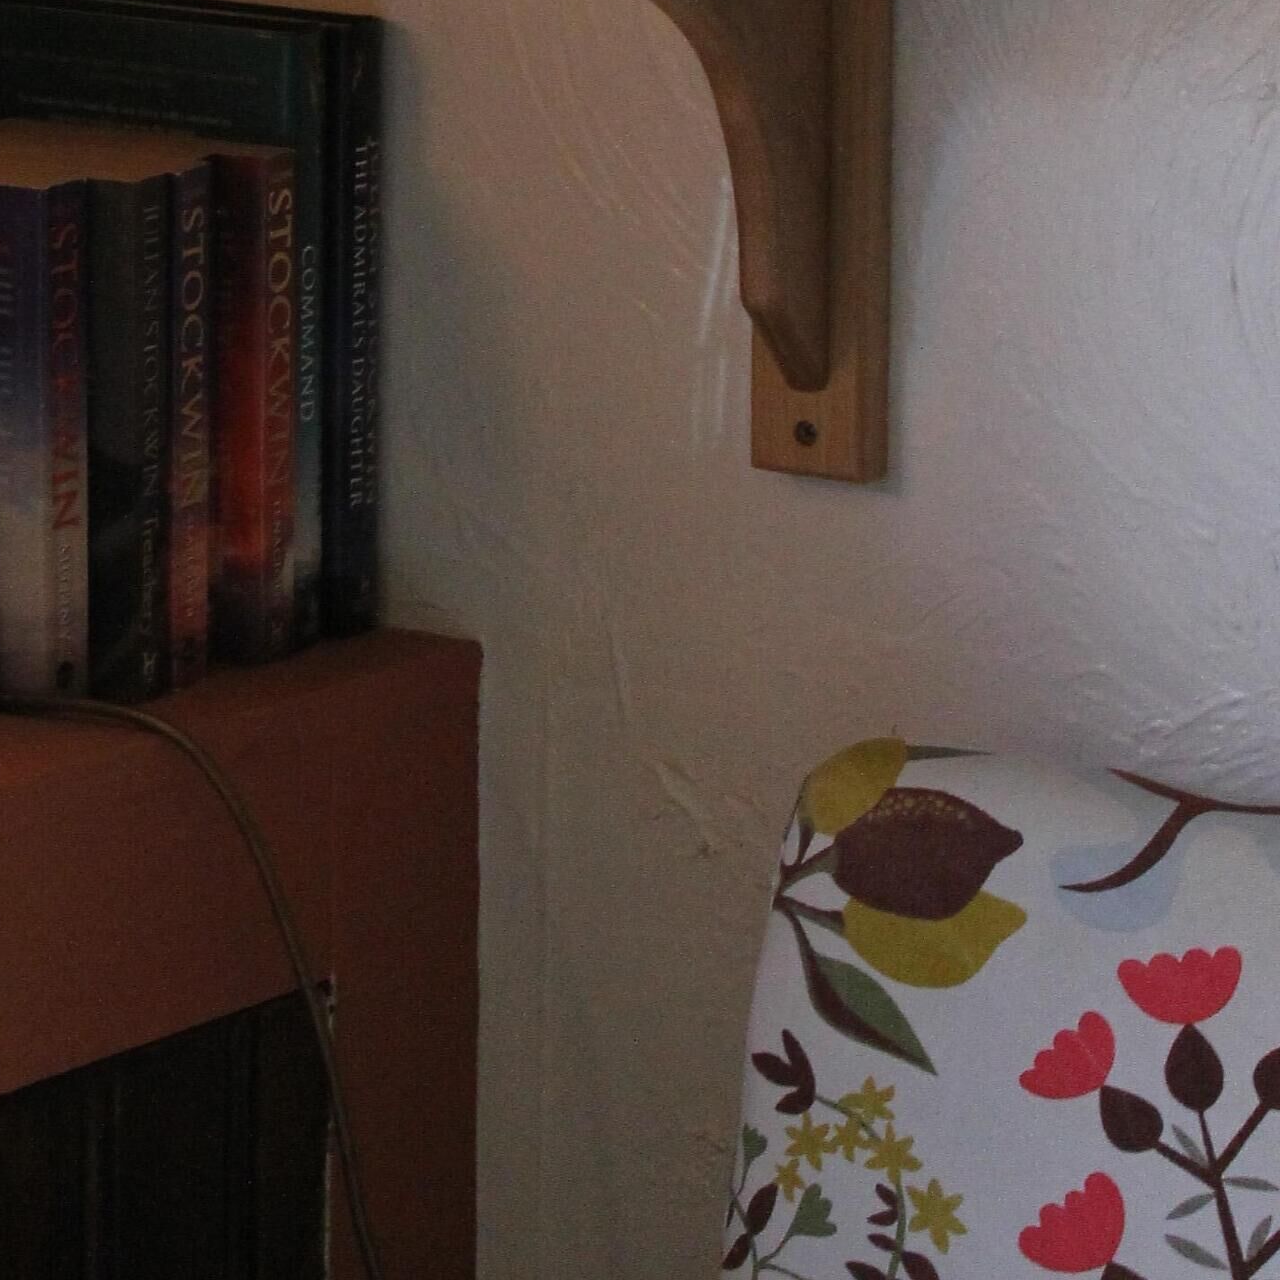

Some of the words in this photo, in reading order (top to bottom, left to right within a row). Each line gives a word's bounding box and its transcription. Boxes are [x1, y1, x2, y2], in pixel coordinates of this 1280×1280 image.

[354, 144, 369, 189] THE
[179, 203, 210, 511] STOCKWIN
[268, 188, 294, 493] STOCKWIN
[299, 242, 319, 425] COMMAND
[351, 204, 368, 351] ADMIRAL'S
[348, 357, 368, 509] DAUGHTER
